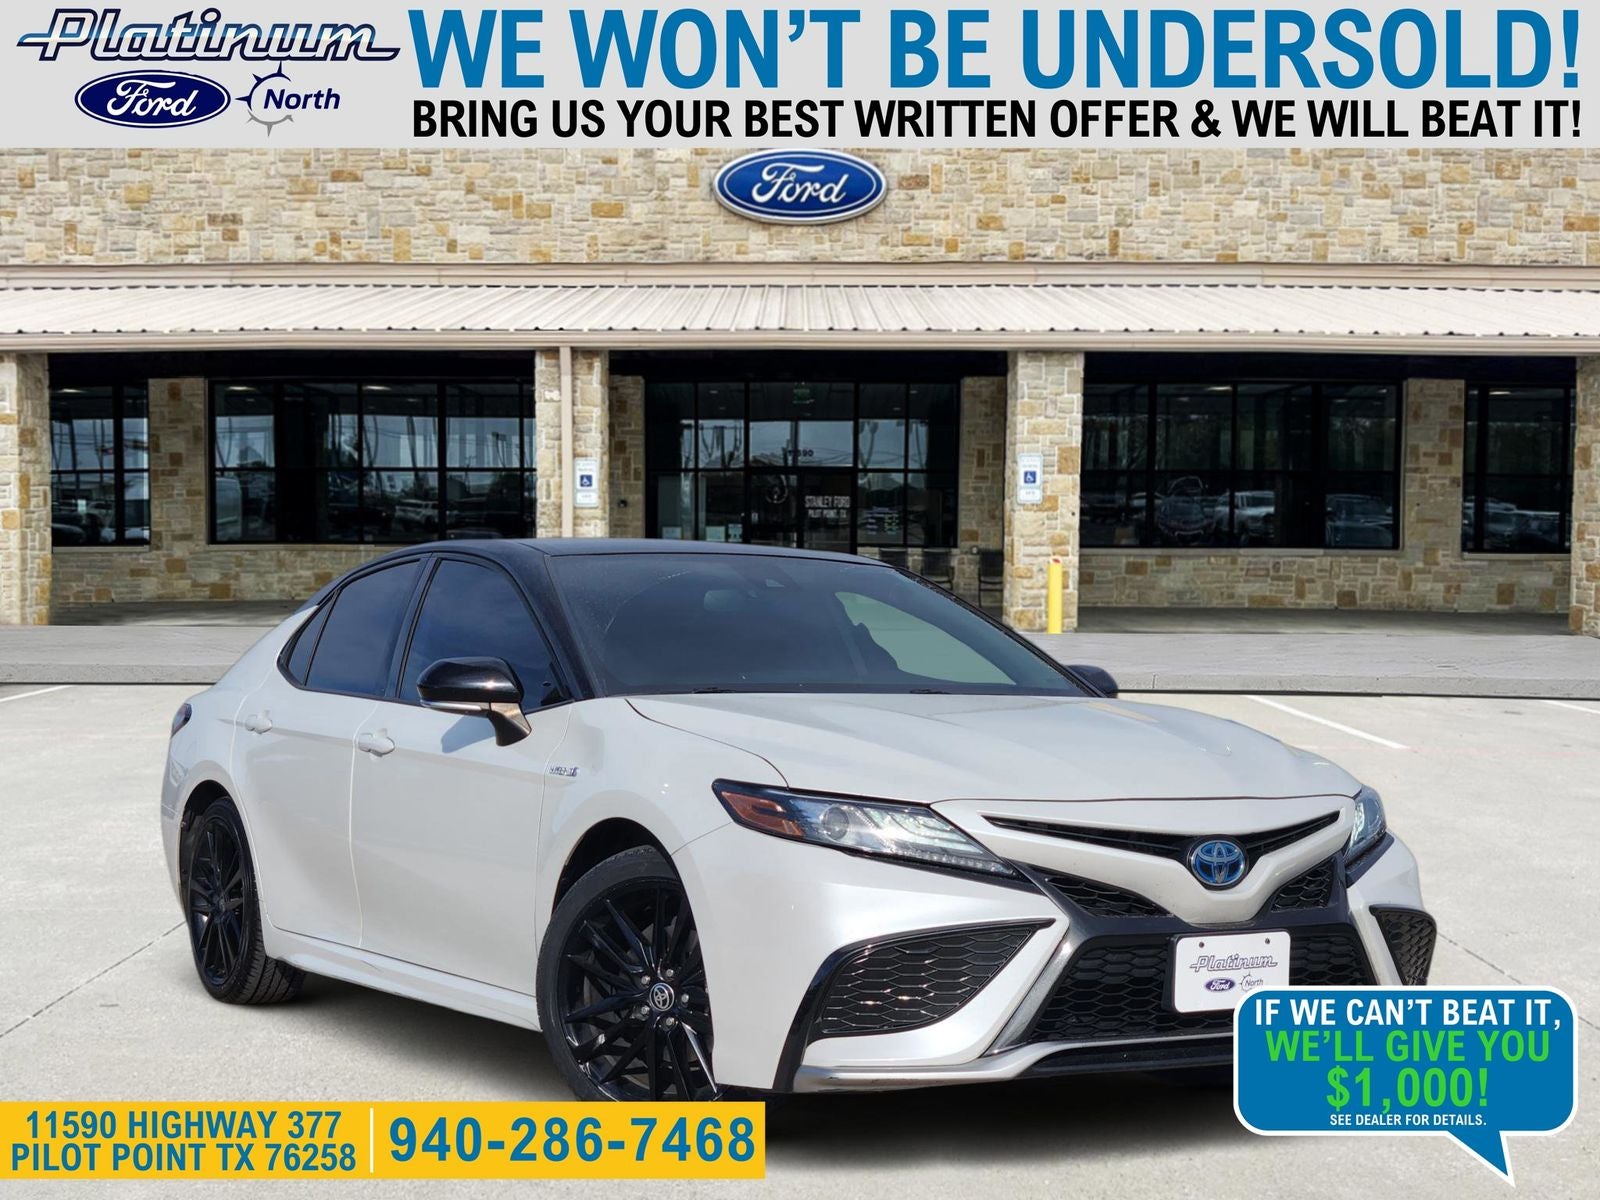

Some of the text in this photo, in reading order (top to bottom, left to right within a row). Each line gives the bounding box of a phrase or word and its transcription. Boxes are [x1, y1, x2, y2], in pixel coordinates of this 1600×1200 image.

[752, 162, 848, 203] Ford
[1190, 954, 1278, 972] Platinum
[1210, 980, 1230, 990] Ford
[1245, 979, 1263, 987] North
